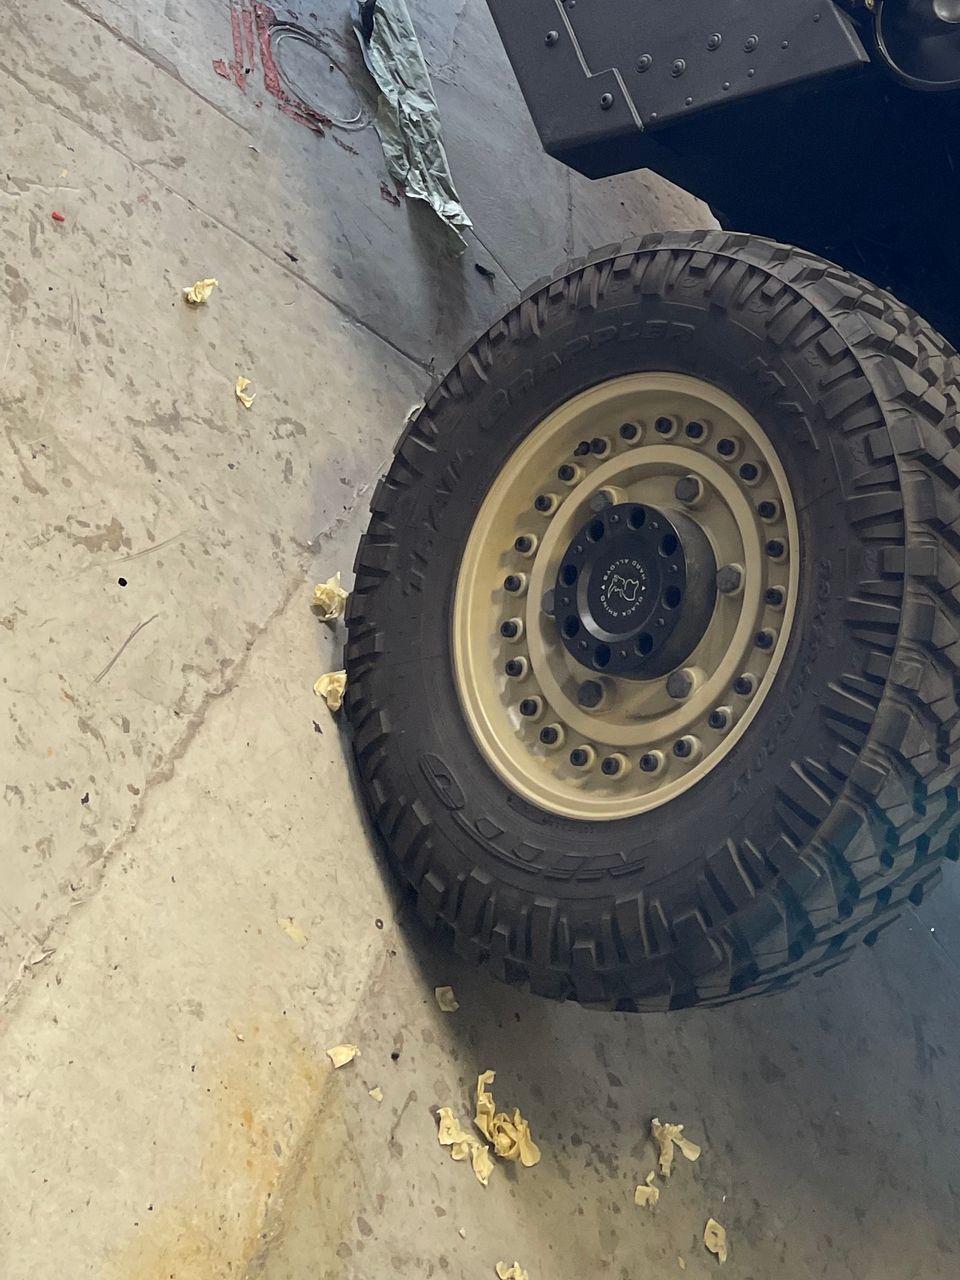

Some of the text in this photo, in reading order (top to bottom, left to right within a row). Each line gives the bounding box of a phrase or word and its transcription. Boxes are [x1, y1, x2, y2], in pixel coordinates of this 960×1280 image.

[603, 558, 646, 581] HARD ALLOYS
[601, 595, 644, 617] BLACK RHINO
